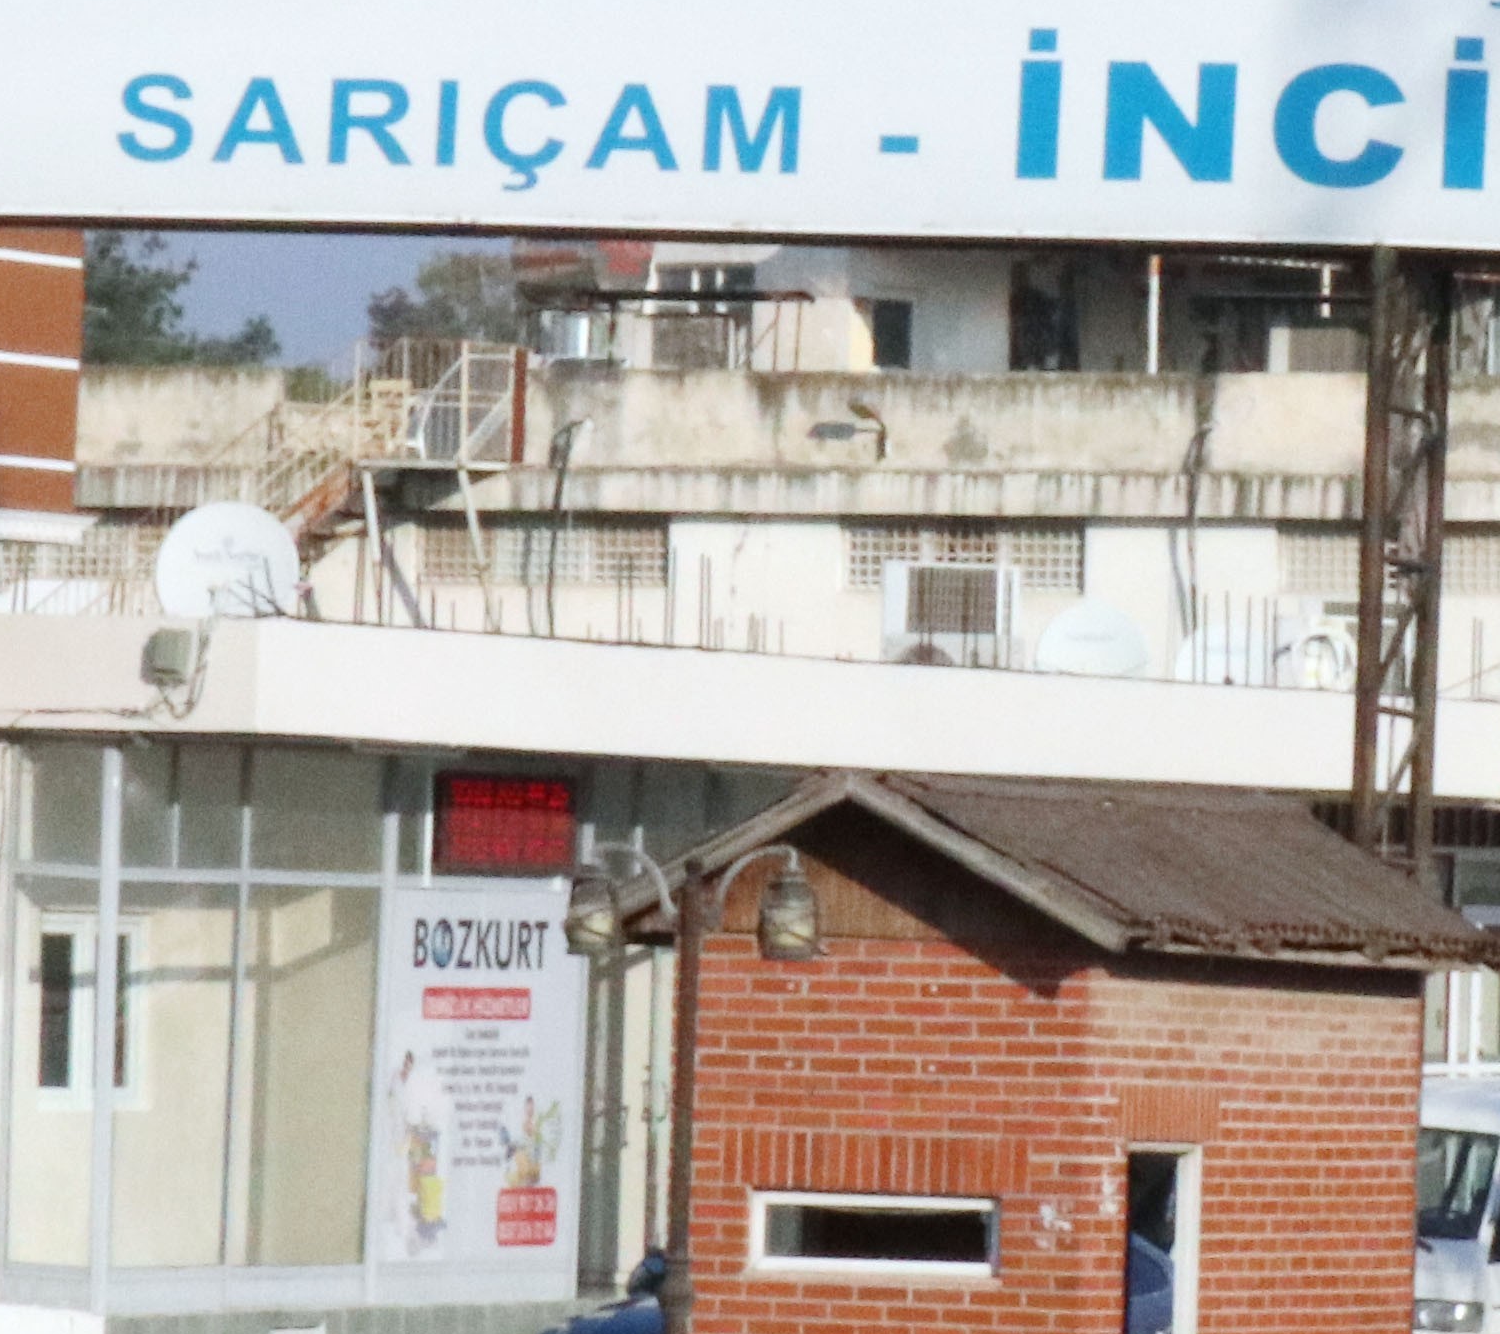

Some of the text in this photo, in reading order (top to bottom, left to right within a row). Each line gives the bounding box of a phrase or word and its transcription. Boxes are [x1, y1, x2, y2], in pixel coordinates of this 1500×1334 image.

[117, 72, 803, 191] SARIÇAM
[879, 134, 921, 155] -
[412, 917, 550, 971] BOZKURT
